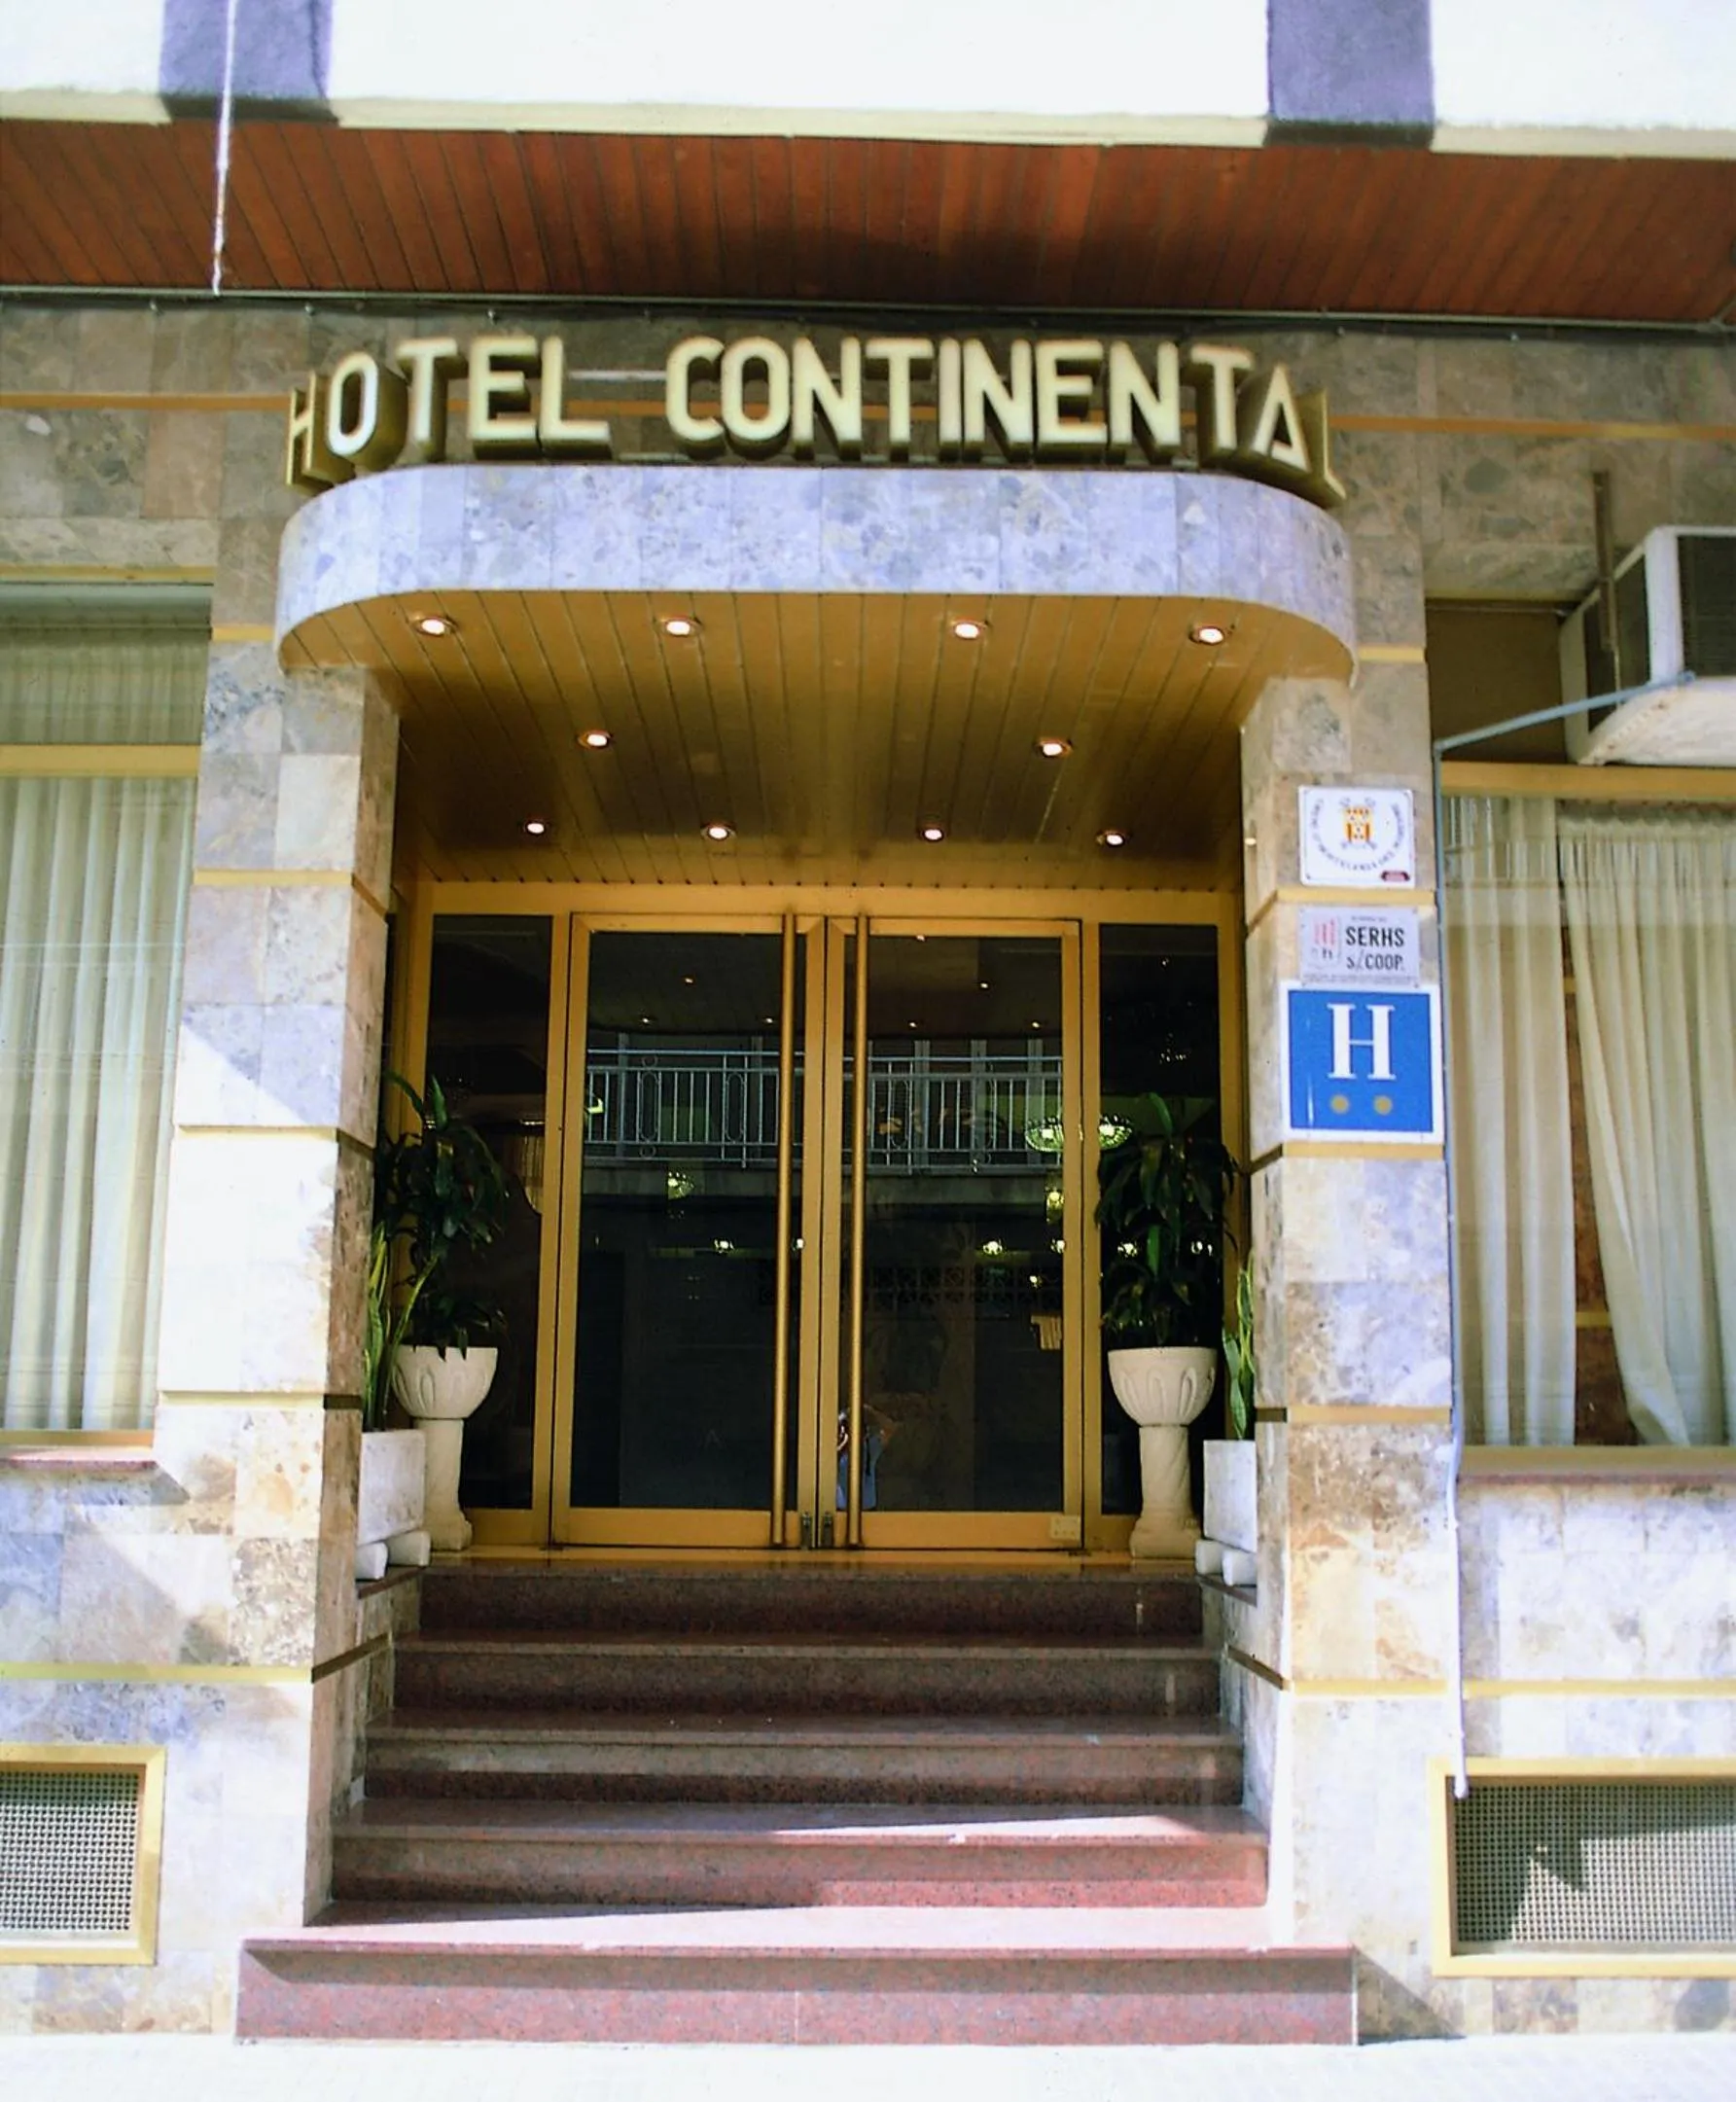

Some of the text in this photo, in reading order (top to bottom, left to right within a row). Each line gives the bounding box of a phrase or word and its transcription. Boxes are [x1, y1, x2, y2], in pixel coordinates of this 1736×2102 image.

[285, 336, 612, 489] HOTEL
[1345, 926, 1405, 947] SERHS
[1327, 1003, 1397, 1081] H
